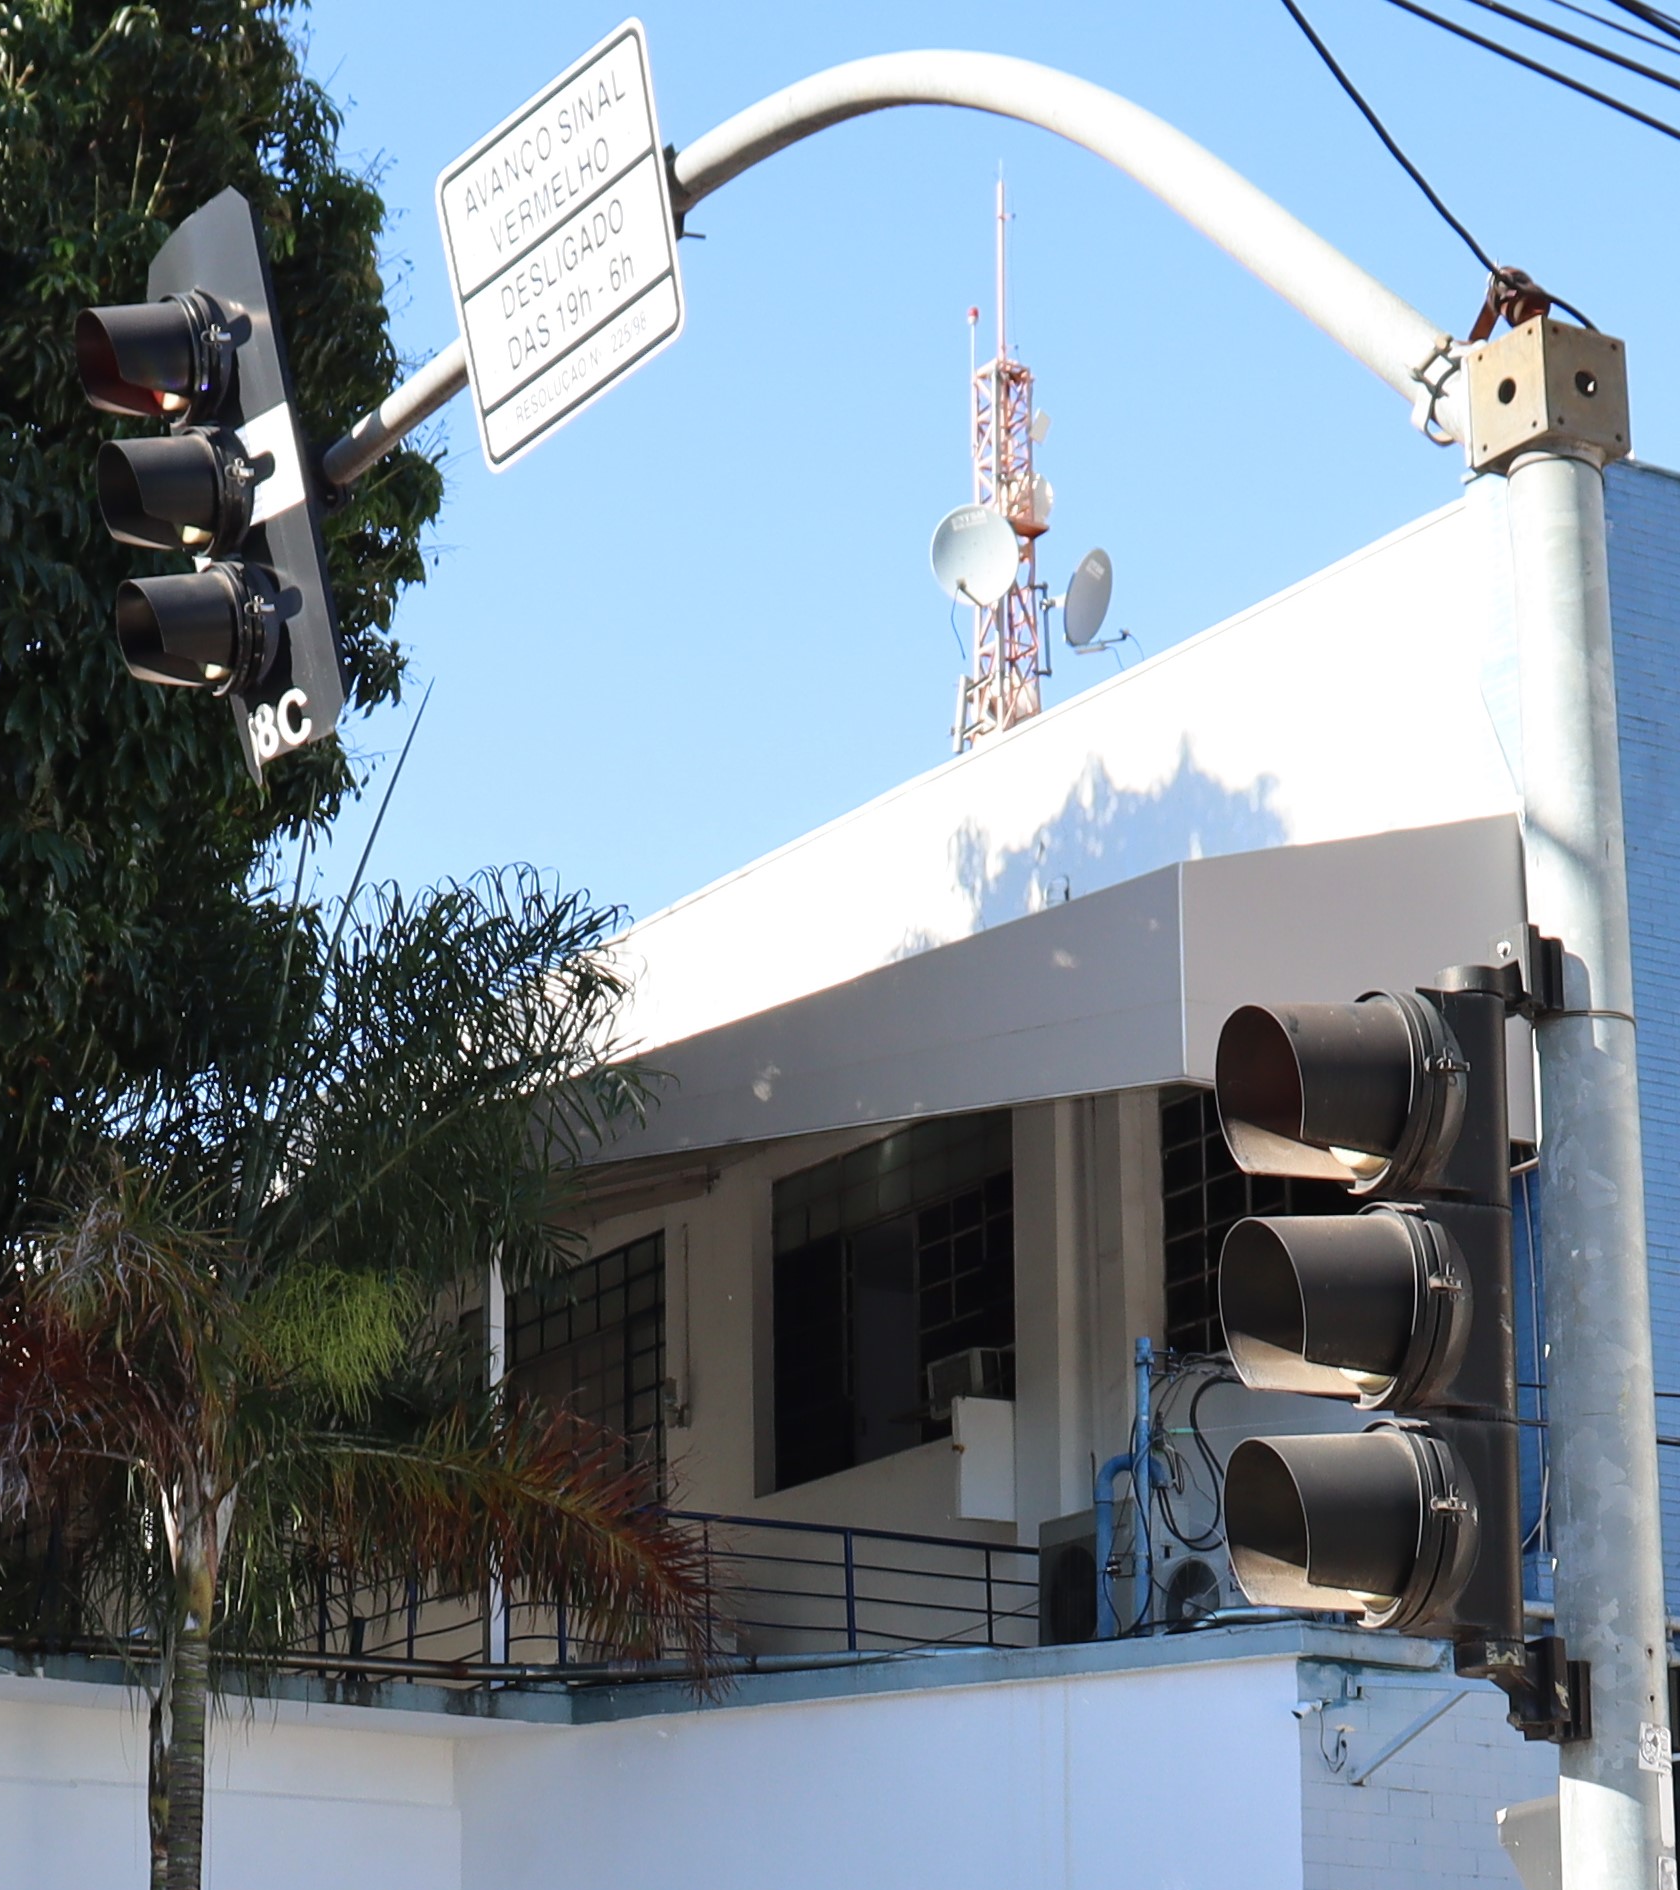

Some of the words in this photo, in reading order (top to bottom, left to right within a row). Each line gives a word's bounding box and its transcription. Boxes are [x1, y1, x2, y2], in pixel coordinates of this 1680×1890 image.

[465, 126, 551, 221] AVANÇO
[558, 70, 626, 144] SINAL
[489, 137, 609, 253] VERMELHO
[501, 198, 623, 320] DESLIGADO
[508, 313, 550, 371] DAS
[556, 284, 592, 332] 19h
[609, 250, 635, 292] 6h
